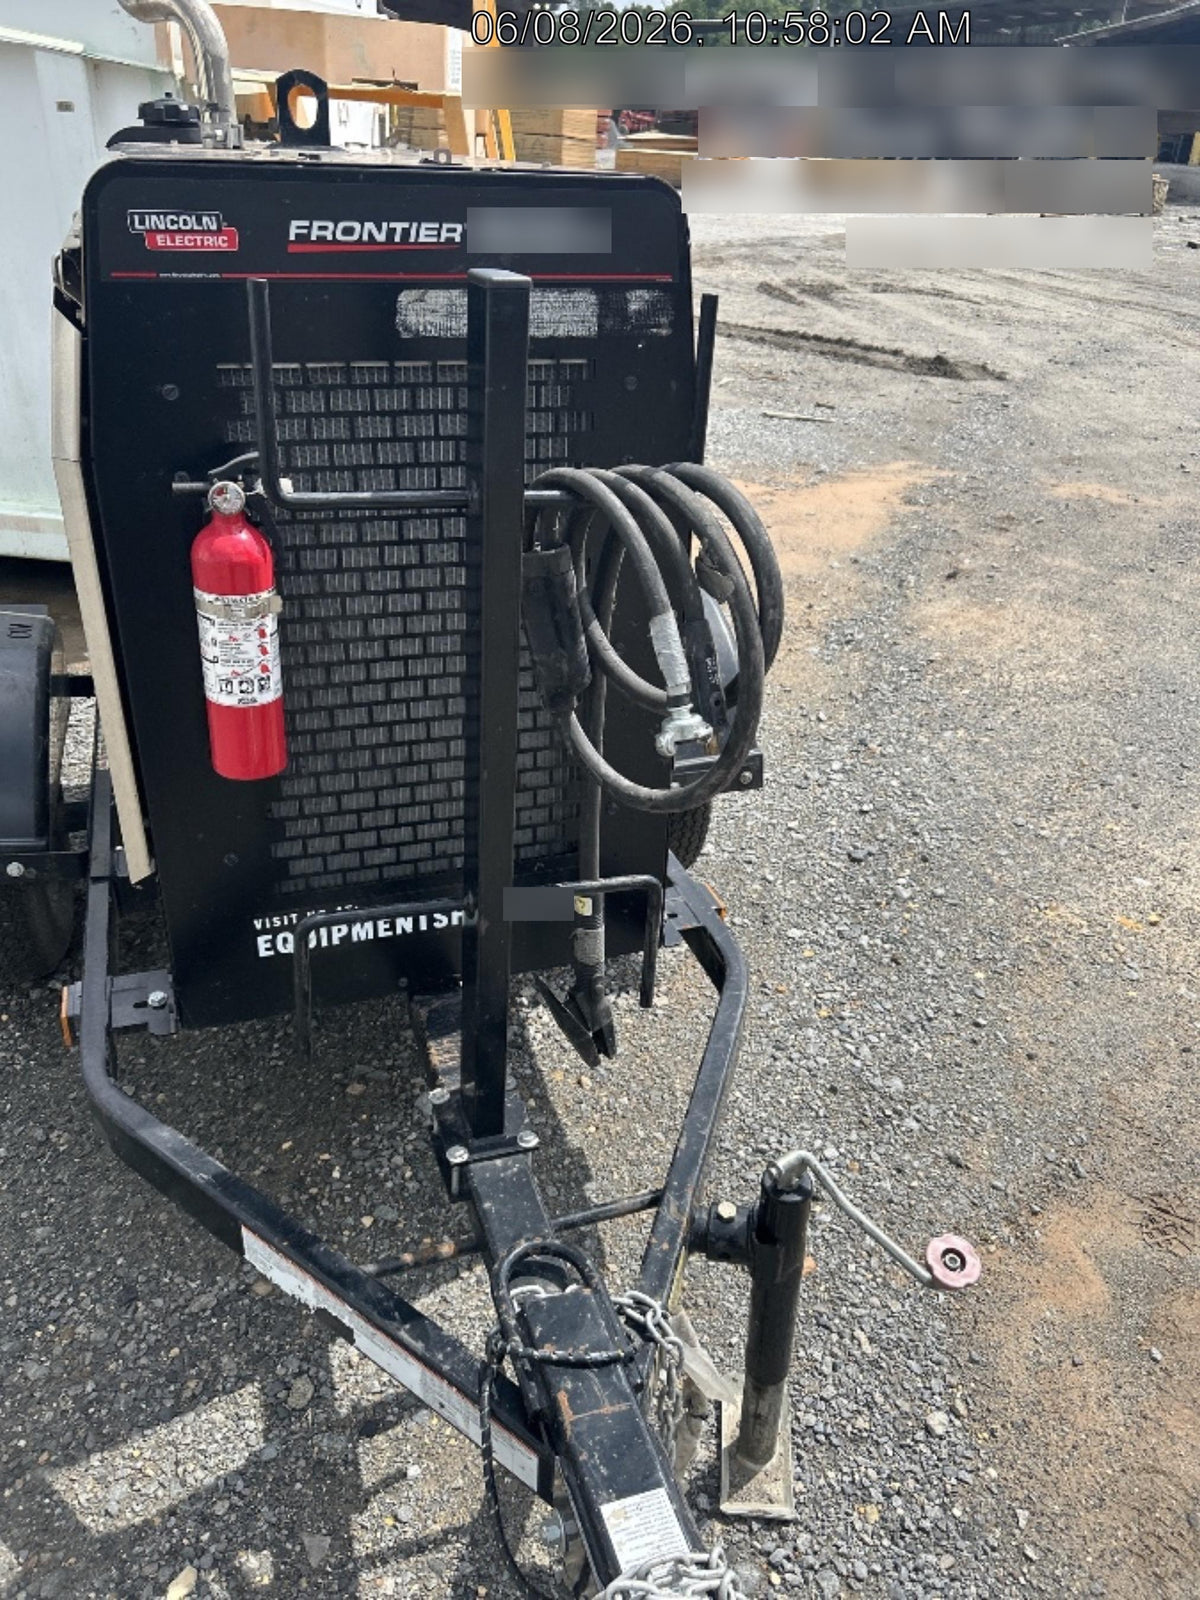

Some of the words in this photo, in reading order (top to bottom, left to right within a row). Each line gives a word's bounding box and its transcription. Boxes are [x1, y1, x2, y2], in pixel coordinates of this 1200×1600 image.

[134, 212, 218, 231] LINCOLN
[288, 220, 463, 243] FRONTIER
[156, 234, 229, 248] ELECTRIC
[253, 913, 299, 930] VISIT
